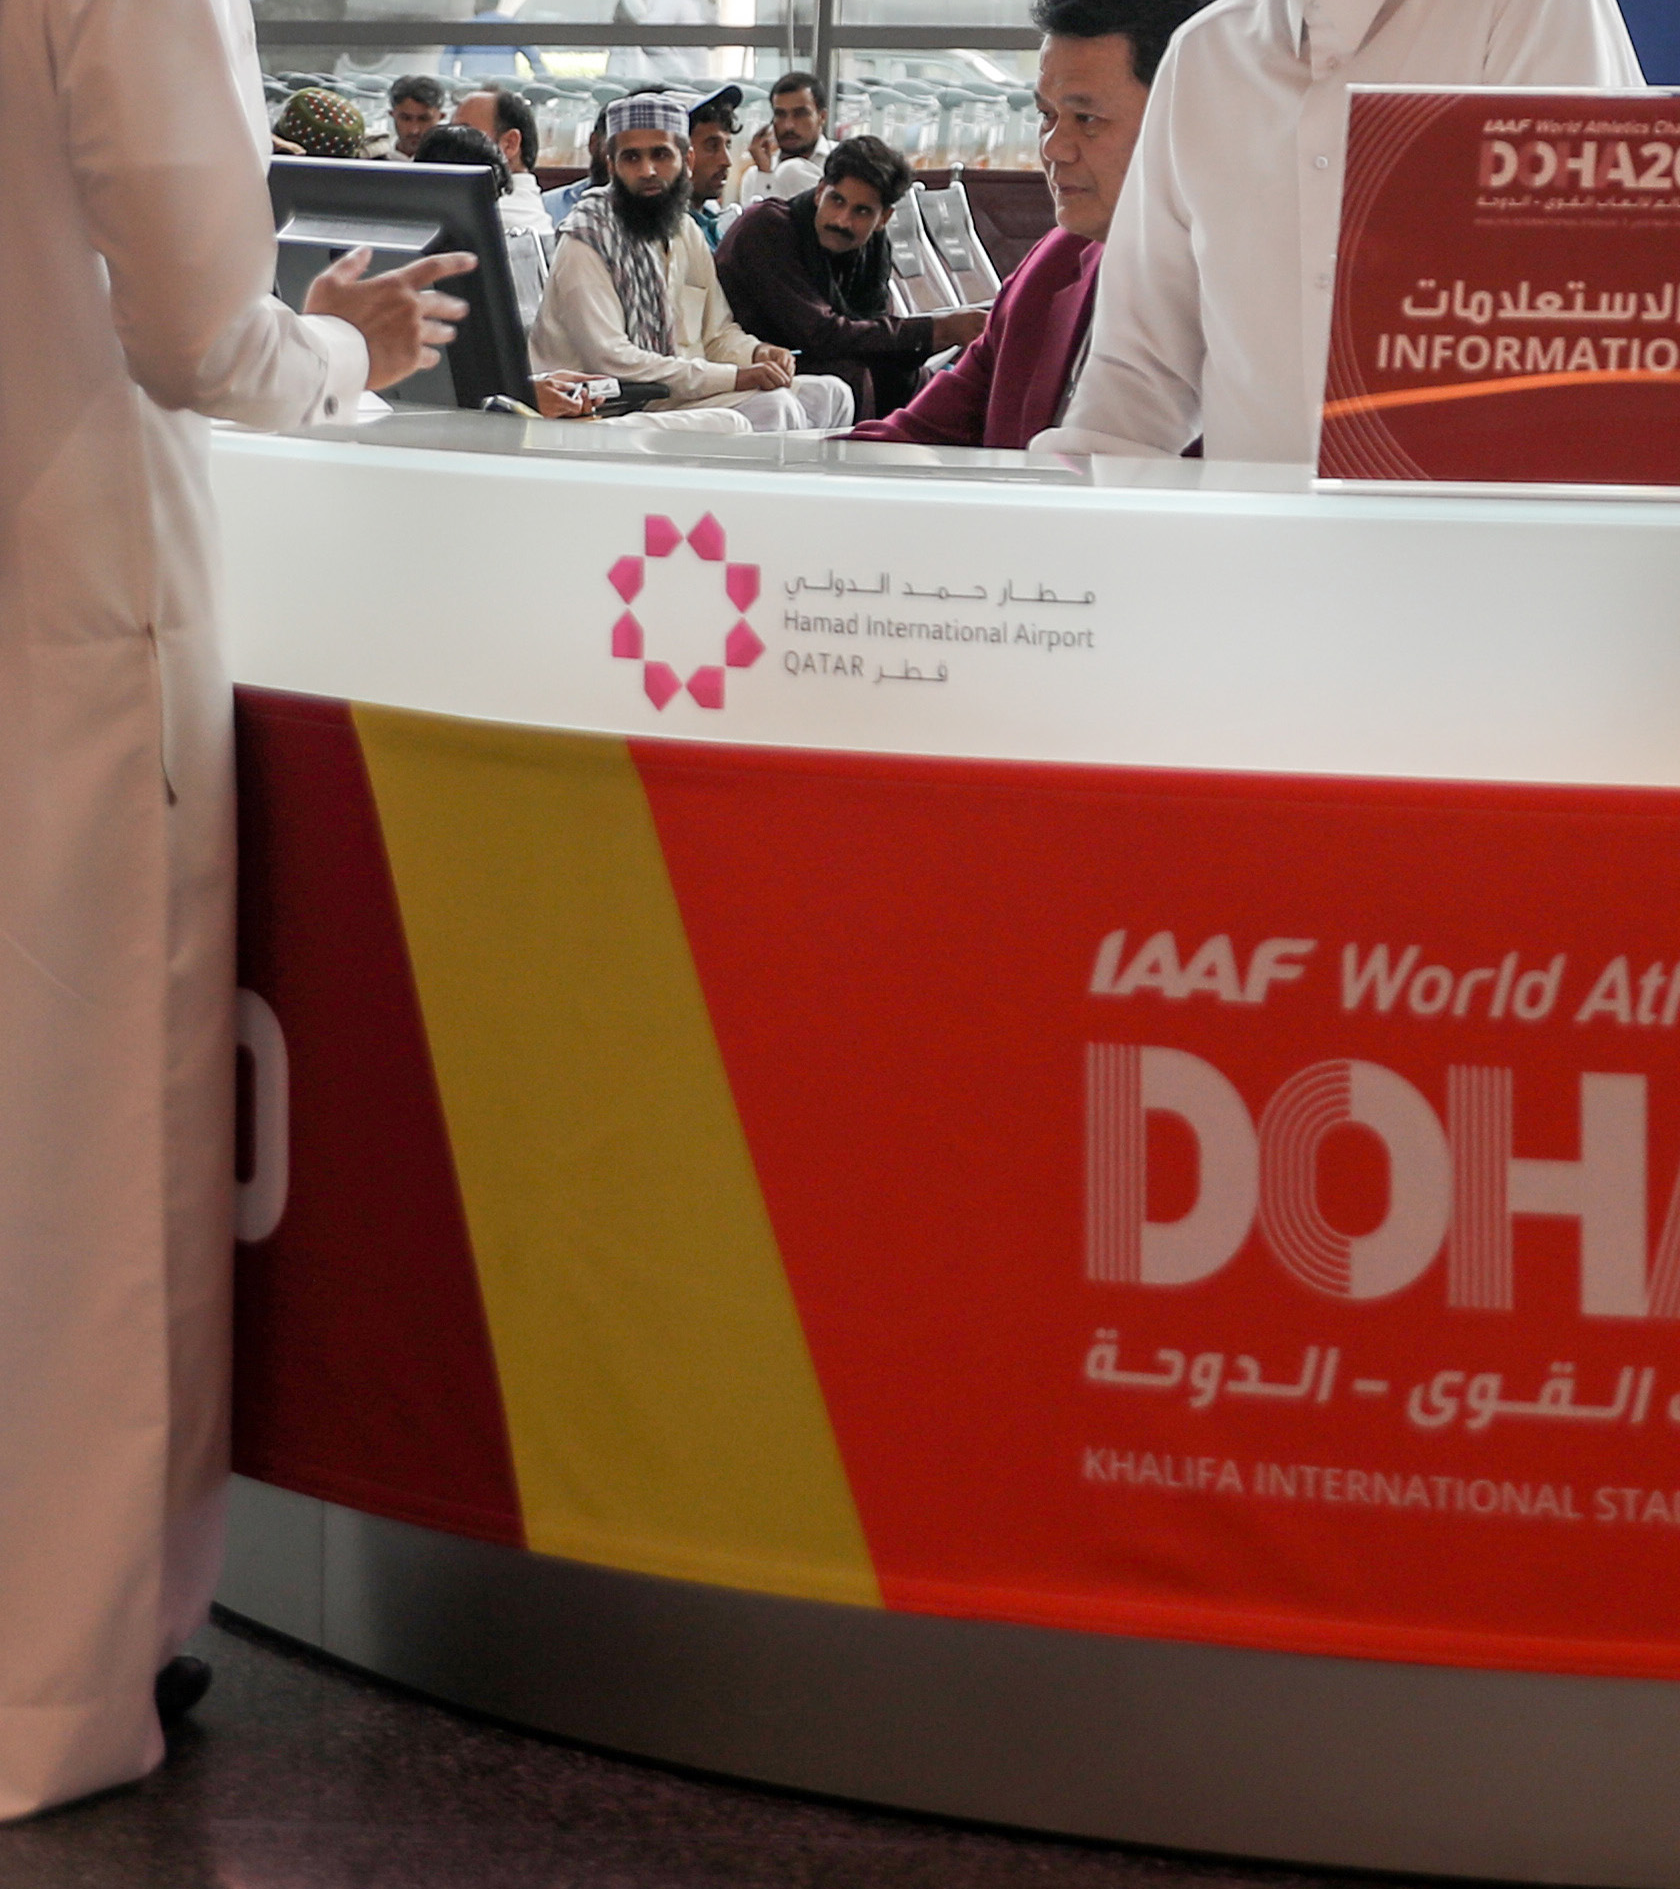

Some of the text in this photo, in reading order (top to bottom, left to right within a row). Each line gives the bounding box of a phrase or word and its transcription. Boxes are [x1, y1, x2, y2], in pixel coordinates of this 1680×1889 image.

[784, 568, 1095, 607] مطار حمد الدولي
[784, 609, 1094, 651] Hamad International Airport
[784, 650, 948, 686] QATAR قطر
[1089, 930, 1316, 1004] IAAF
[1342, 943, 1565, 1021] World
[1084, 1328, 1339, 1409] الدوحة
[1082, 1447, 1244, 1493] KHALIFA
[1253, 1462, 1583, 1520] INTERNATIONAL
